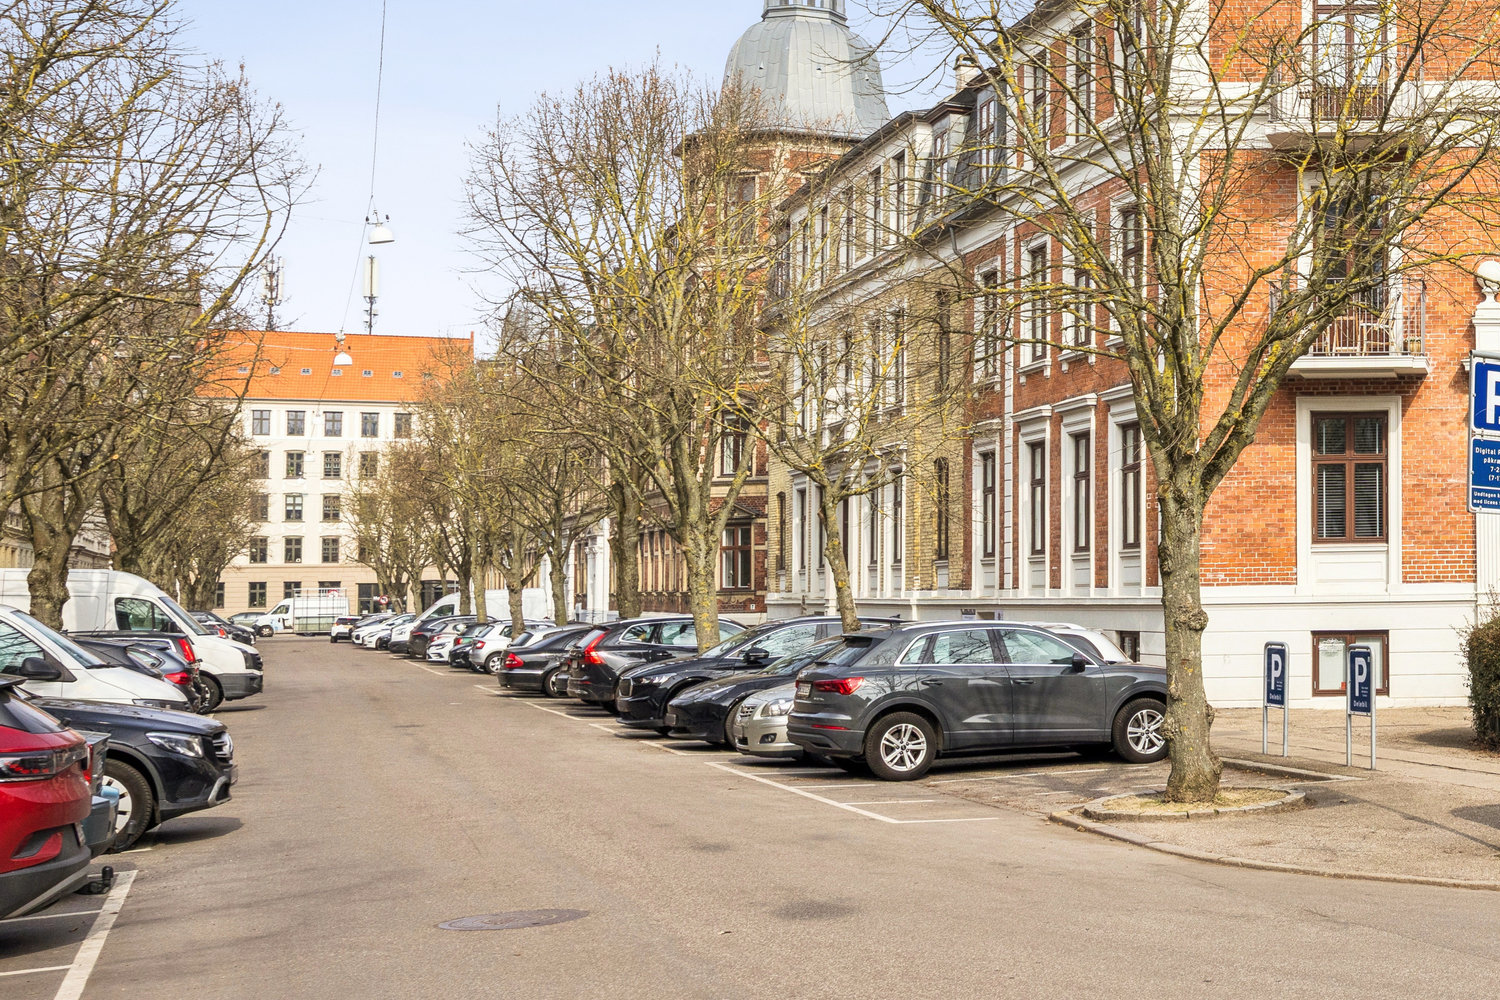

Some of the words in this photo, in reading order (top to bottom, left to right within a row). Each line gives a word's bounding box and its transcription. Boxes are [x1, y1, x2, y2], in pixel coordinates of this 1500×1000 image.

[1475, 447, 1496, 455] Digital
[1271, 653, 1282, 690] P
[1355, 657, 1367, 697] P
[1269, 693, 1282, 701] Delebil
[1353, 700, 1368, 708] Delebil
